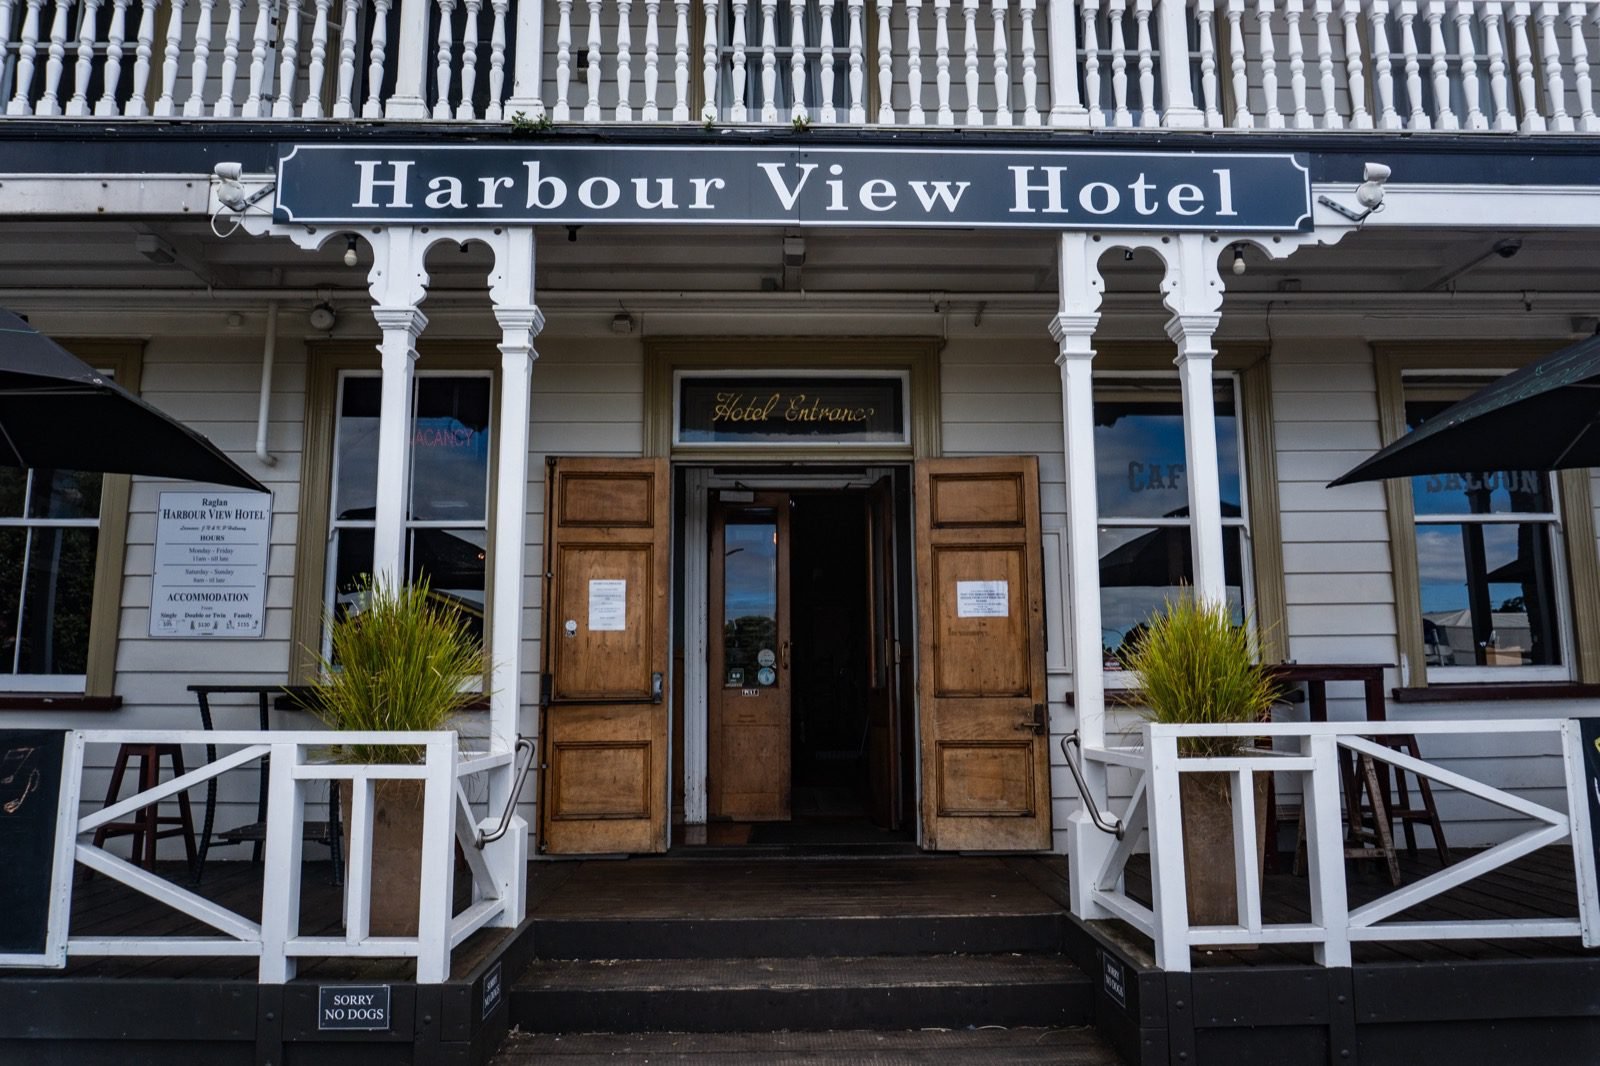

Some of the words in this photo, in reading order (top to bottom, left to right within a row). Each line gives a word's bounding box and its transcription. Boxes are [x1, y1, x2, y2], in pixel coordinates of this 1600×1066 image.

[351, 160, 726, 210] Harbour
[756, 162, 971, 213] View
[1007, 165, 1239, 217] Hotel
[712, 392, 780, 422] Hotel
[411, 429, 473, 447] ACANCY
[1128, 460, 1186, 493] CAF
[202, 498, 228, 507] Raglan
[163, 508, 206, 520] HARBOUR
[208, 508, 233, 520] VIEW
[235, 508, 266, 520] HOTEL
[216, 547, 234, 555] Friday
[185, 568, 209, 576] Saturday
[214, 568, 234, 576] Sunday
[167, 592, 249, 602] ACCOMMODATION
[233, 612, 253, 620] Family
[333, 994, 375, 1006] SORRY
[325, 1008, 345, 1020] NO
[347, 1008, 384, 1020] DOGS
